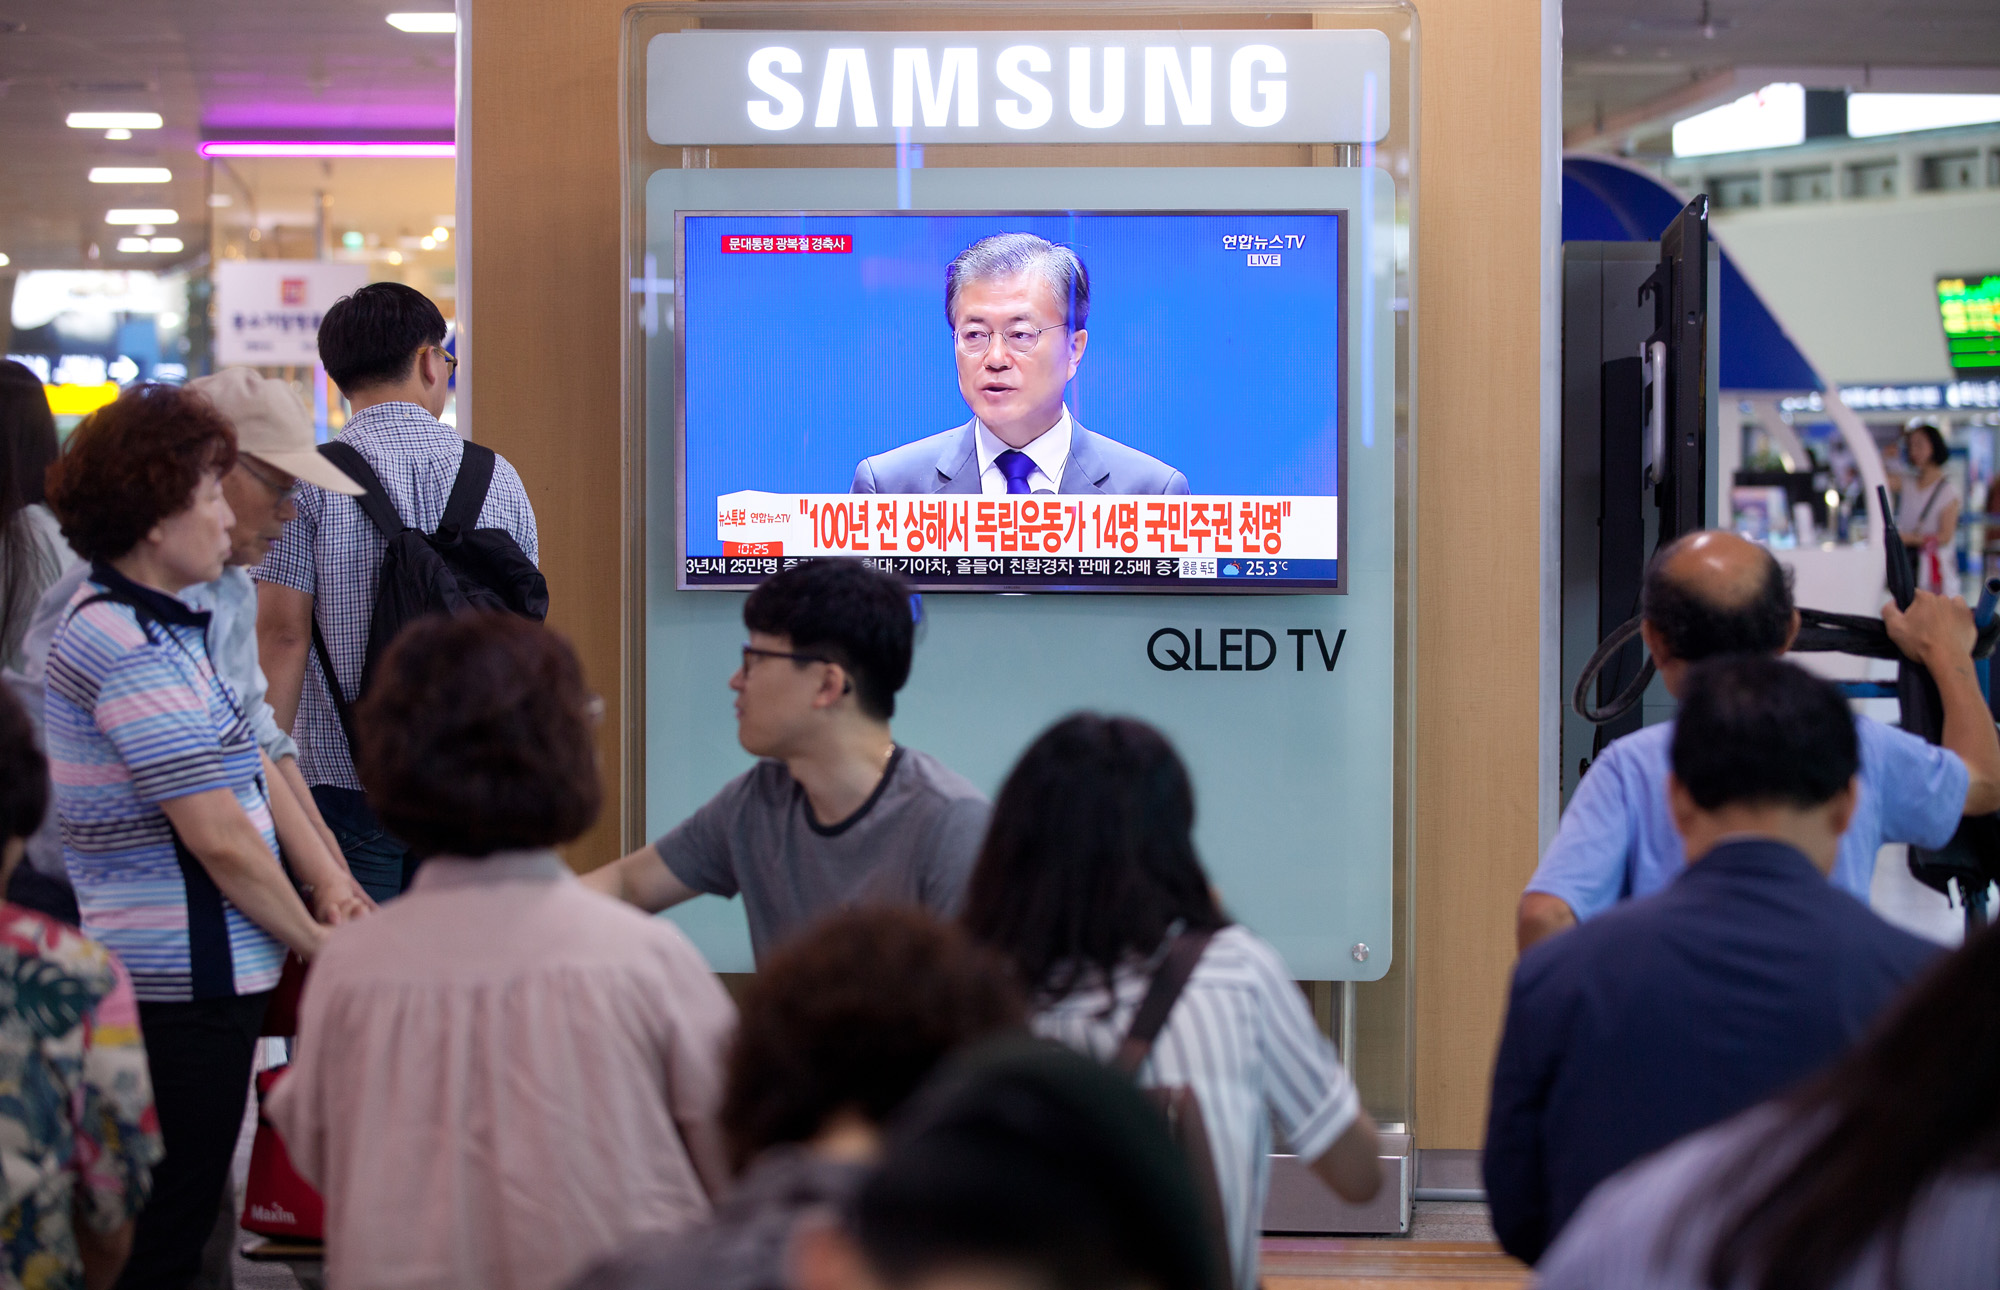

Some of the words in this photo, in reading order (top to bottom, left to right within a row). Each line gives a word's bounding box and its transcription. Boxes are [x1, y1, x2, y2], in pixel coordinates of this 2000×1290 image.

[747, 45, 1287, 131] SAMSUNG
[729, 238, 774, 251] 문대통령
[776, 237, 809, 251] 광복절
[812, 237, 845, 251] 경축사
[1222, 234, 1306, 250] 연합뉴스TV
[1250, 255, 1279, 265] LIVE
[719, 509, 746, 527] 뉴스특보
[750, 512, 791, 524] 연합뉴스TV
[876, 500, 898, 551] 전
[903, 500, 969, 553] 상해서
[975, 500, 1086, 553] 독립운동가
[1092, 501, 1139, 553] 14명
[1145, 501, 1233, 553] 국민주권
[737, 544, 769, 555] 10:25
[686, 558, 726, 574] 3년새
[730, 558, 778, 574] 25만명
[783, 558, 814, 572] 증
[956, 558, 1004, 575] 올들어
[1009, 558, 1074, 575] 친환경차
[1078, 558, 1110, 575] 판매
[1114, 559, 1151, 575] 2.5배
[1182, 561, 1198, 575] 울릉
[1200, 561, 1215, 575] 독도
[1147, 627, 1277, 671] QLED
[1287, 629, 1347, 671] TV
